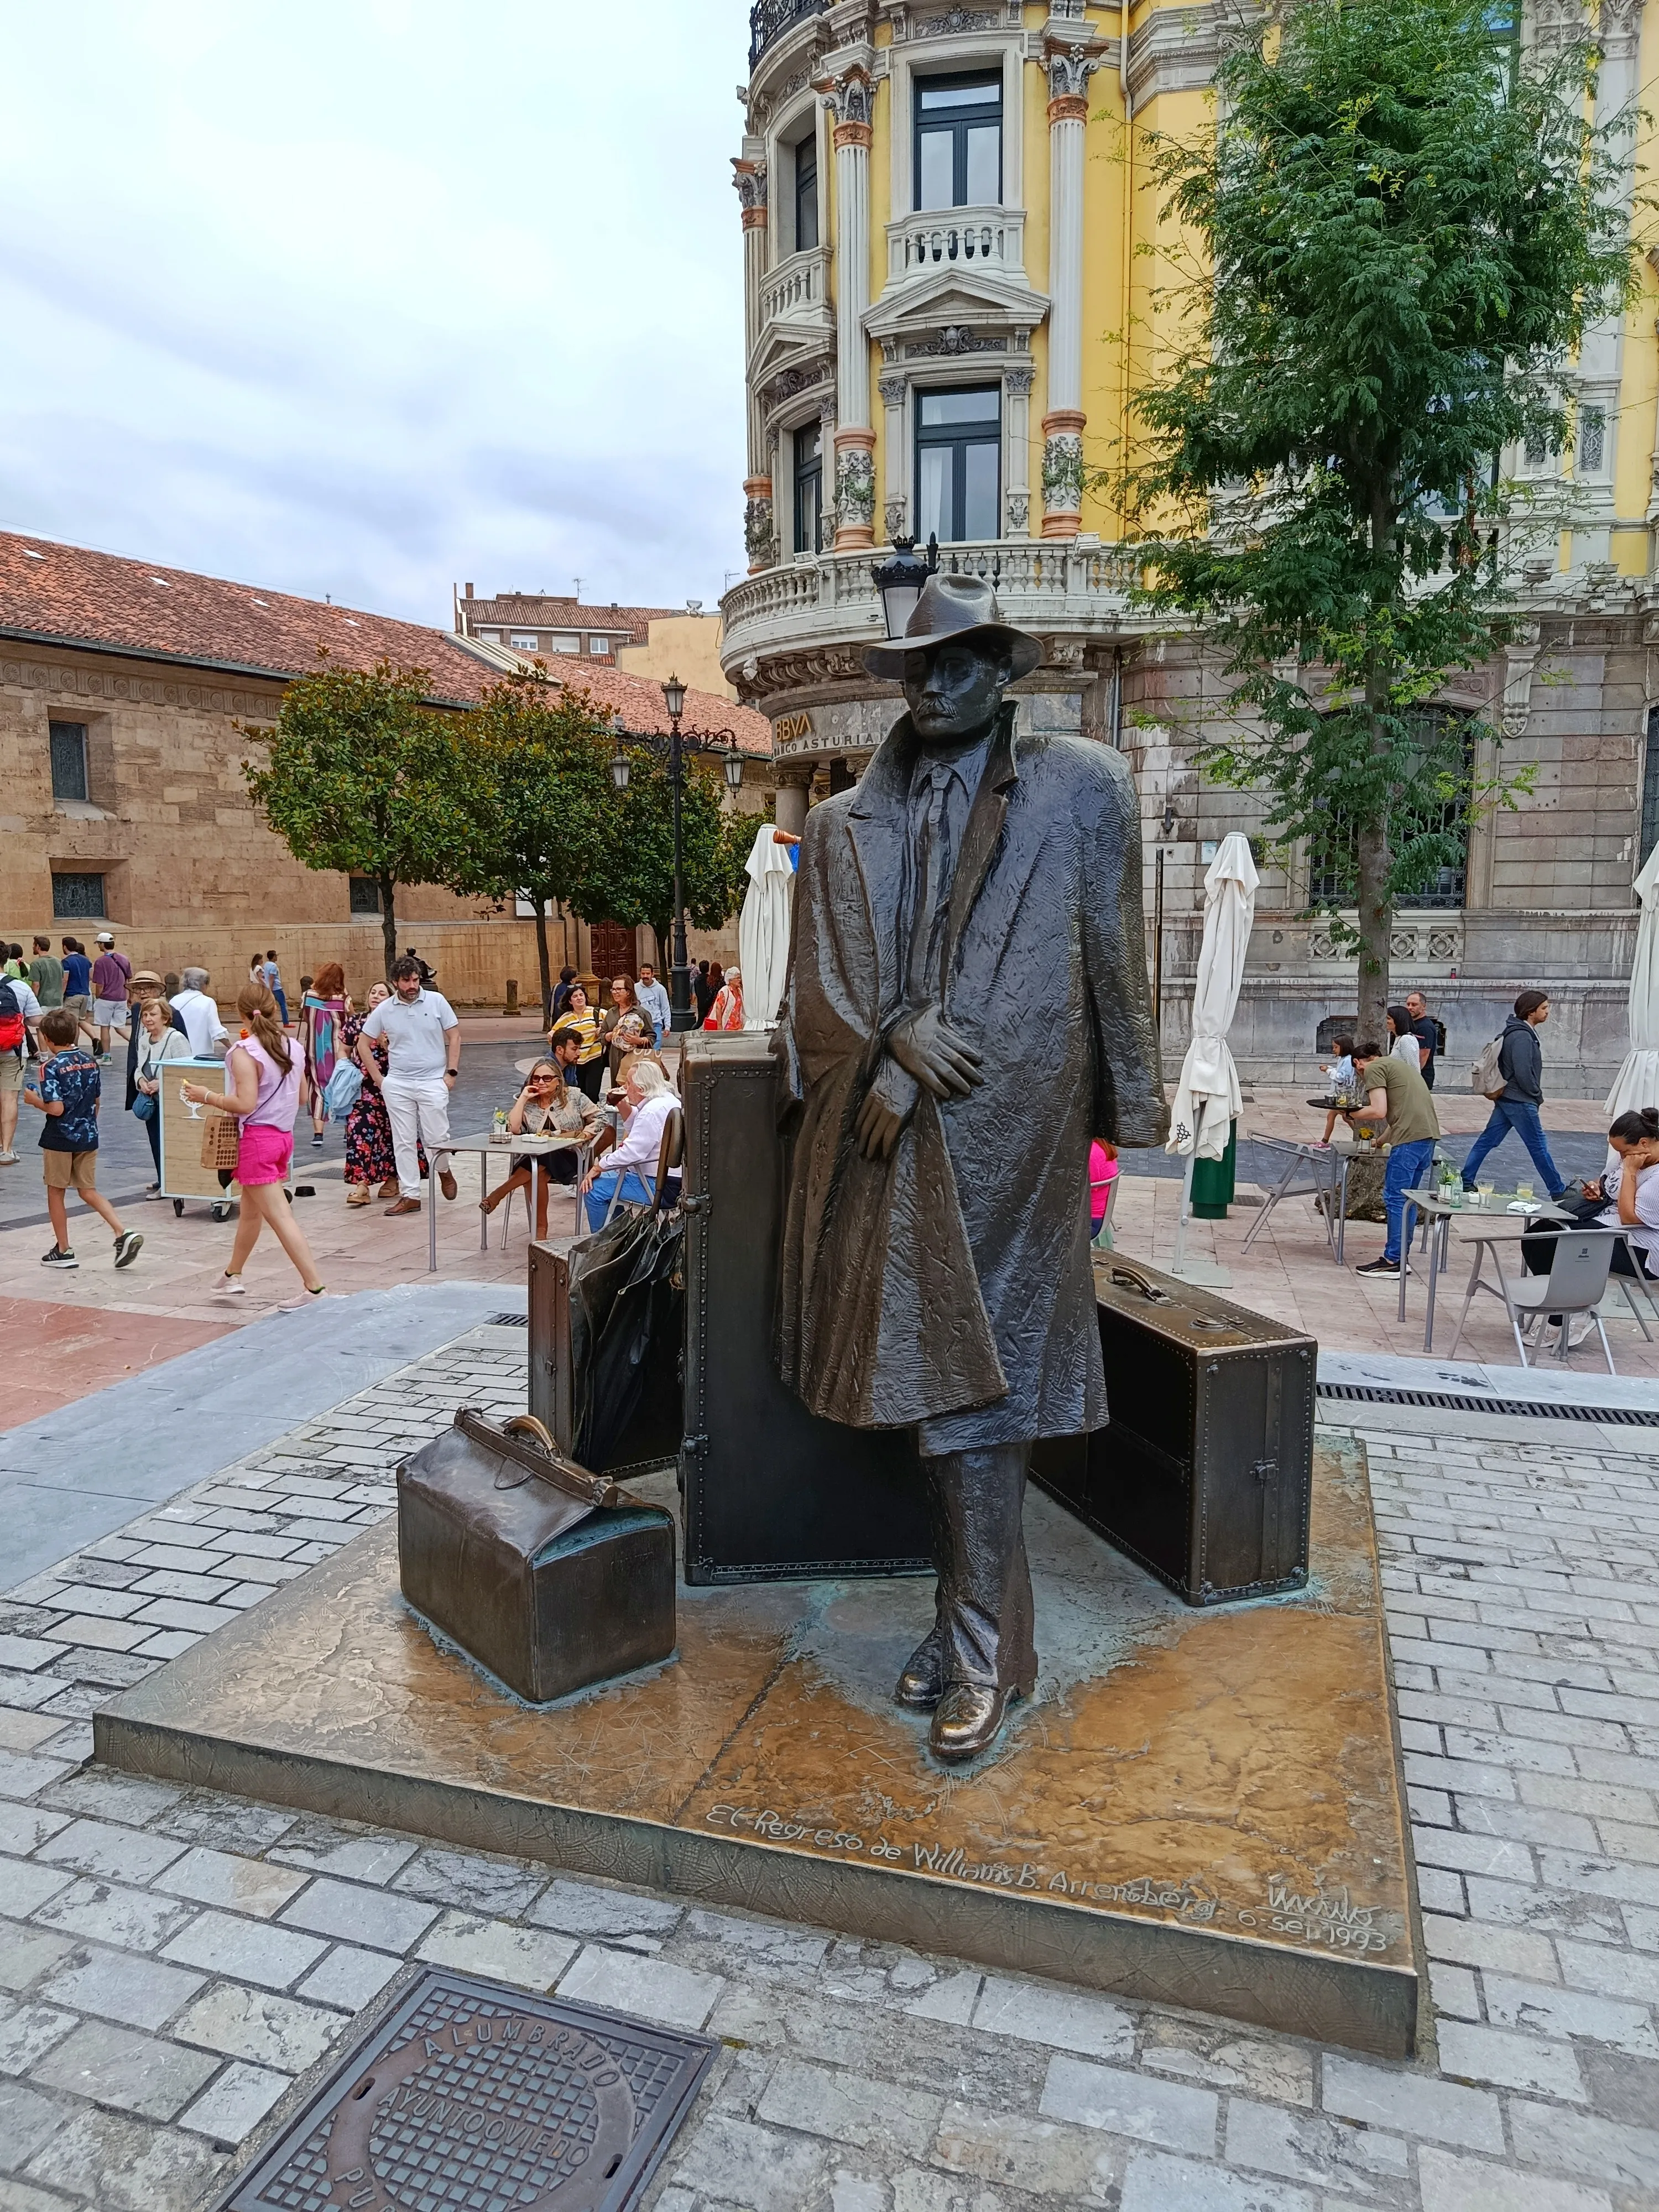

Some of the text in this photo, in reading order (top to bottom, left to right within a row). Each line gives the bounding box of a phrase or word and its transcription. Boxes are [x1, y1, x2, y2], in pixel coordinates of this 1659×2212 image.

[776, 712, 812, 742] BBVA
[754, 1809, 863, 1850] Regreso
[870, 1837, 901, 1860] de
[915, 1842, 1015, 1885] Williams
[1015, 1863, 1041, 1890] B.
[1048, 1871, 1217, 1921] Arrensberg
[425, 2020, 620, 2087] ALUMBRADO
